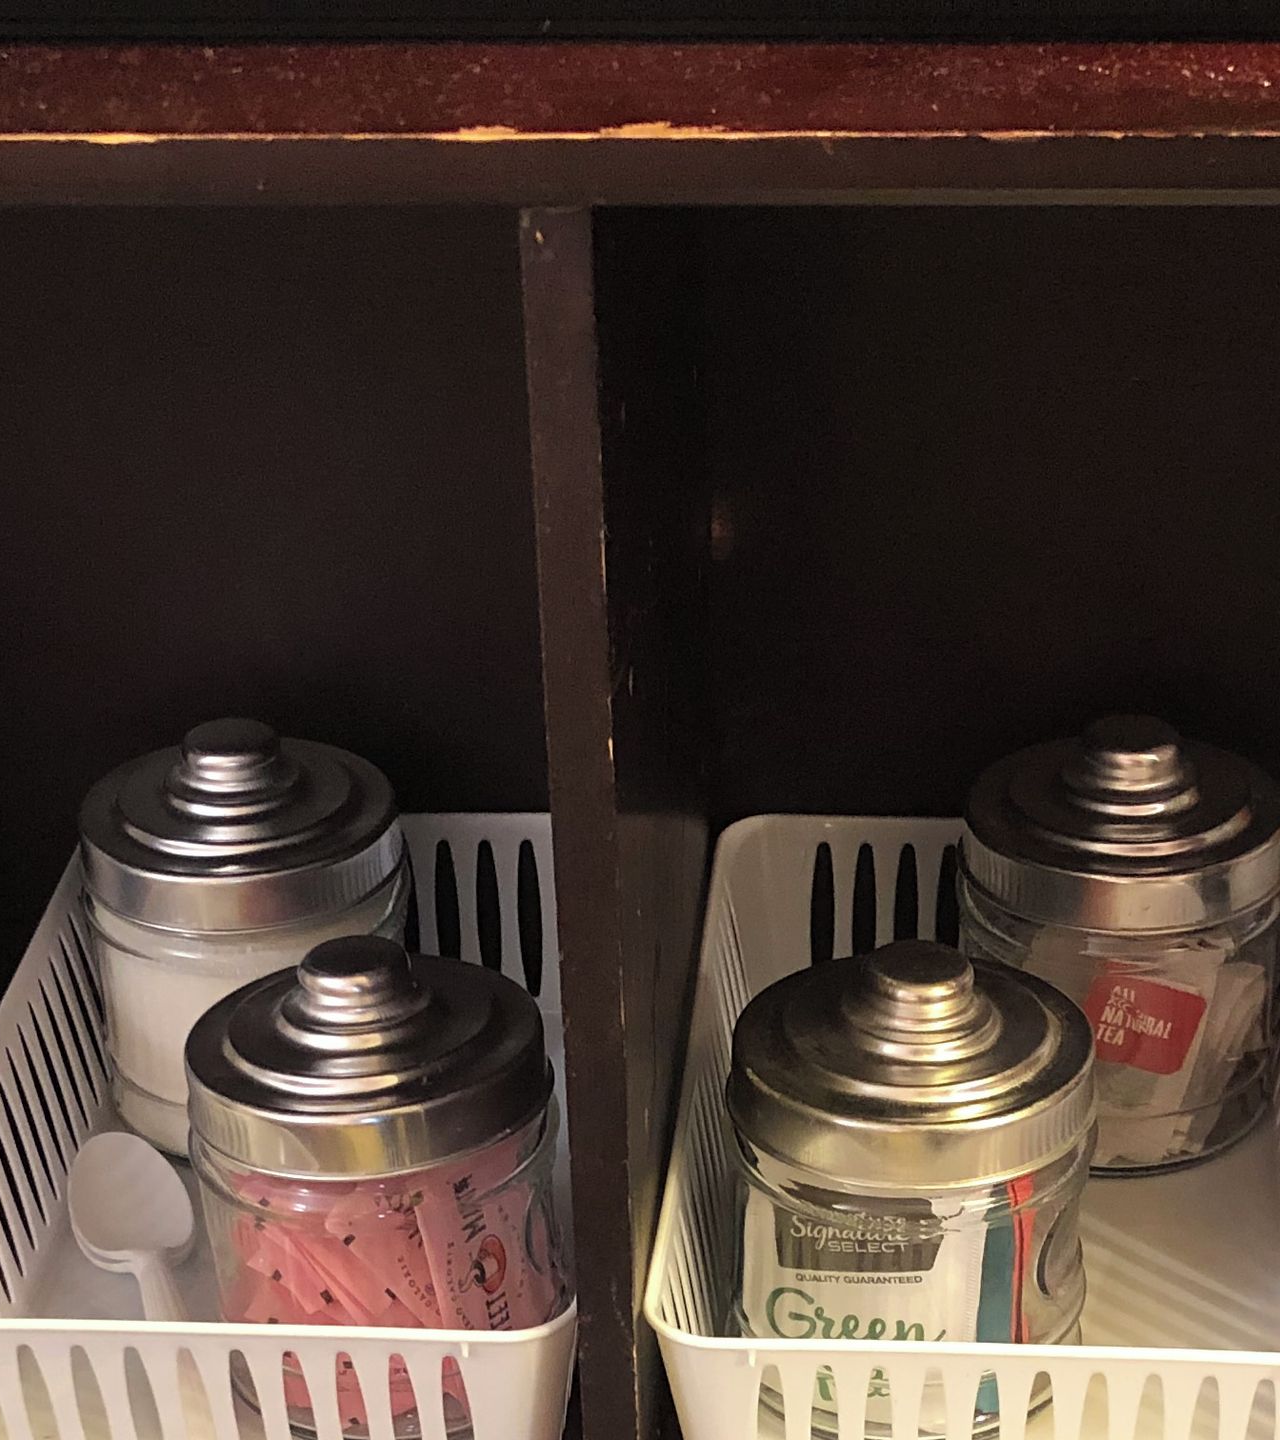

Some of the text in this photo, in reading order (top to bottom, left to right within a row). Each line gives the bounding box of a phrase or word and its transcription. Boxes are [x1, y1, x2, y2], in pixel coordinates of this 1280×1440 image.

[1096, 1023, 1125, 1046] TEA
[827, 1241, 910, 1254] SELECT
[795, 1273, 924, 1285] QUALITY GUARANTEED
